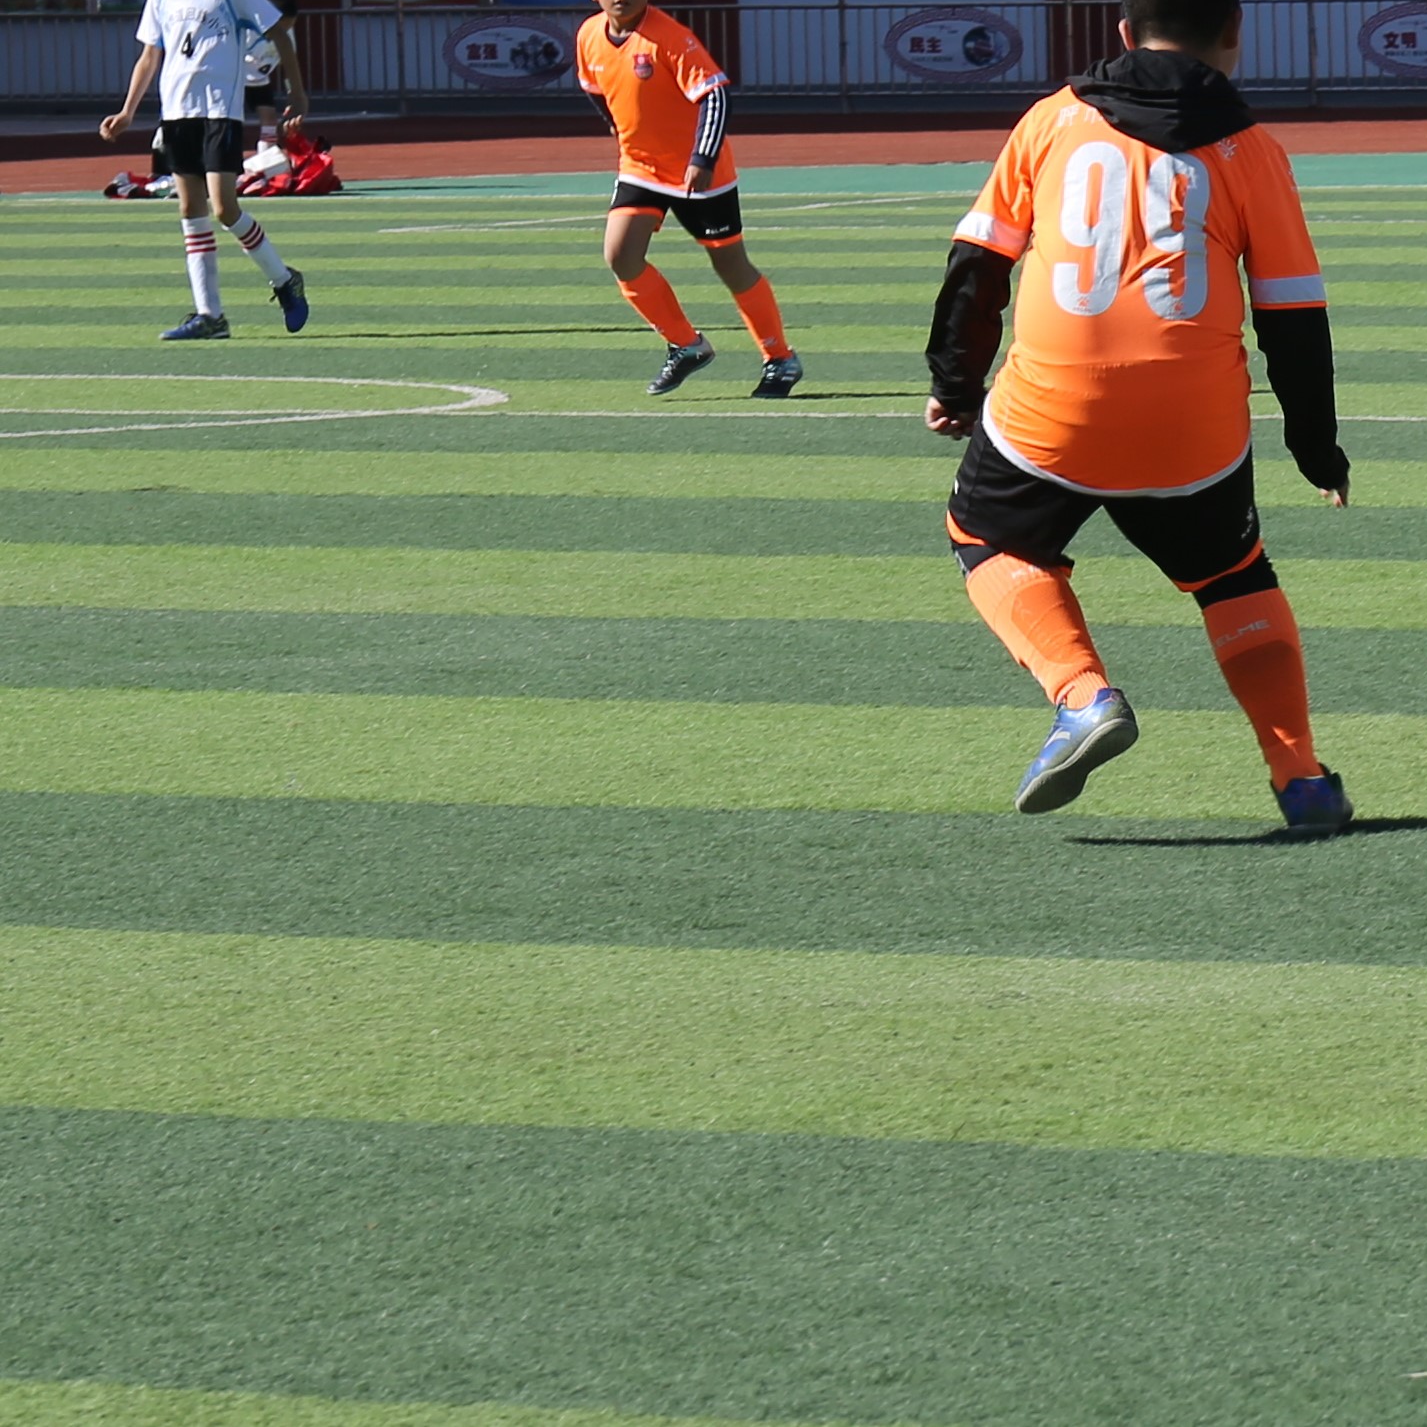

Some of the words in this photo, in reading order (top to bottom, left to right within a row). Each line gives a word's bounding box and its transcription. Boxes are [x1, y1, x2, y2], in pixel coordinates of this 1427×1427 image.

[181, 31, 195, 58] 4
[909, 35, 942, 54] 民主
[1383, 30, 1417, 49] 文明
[1052, 141, 1209, 321] 99
[1214, 619, 1270, 648] ELME
